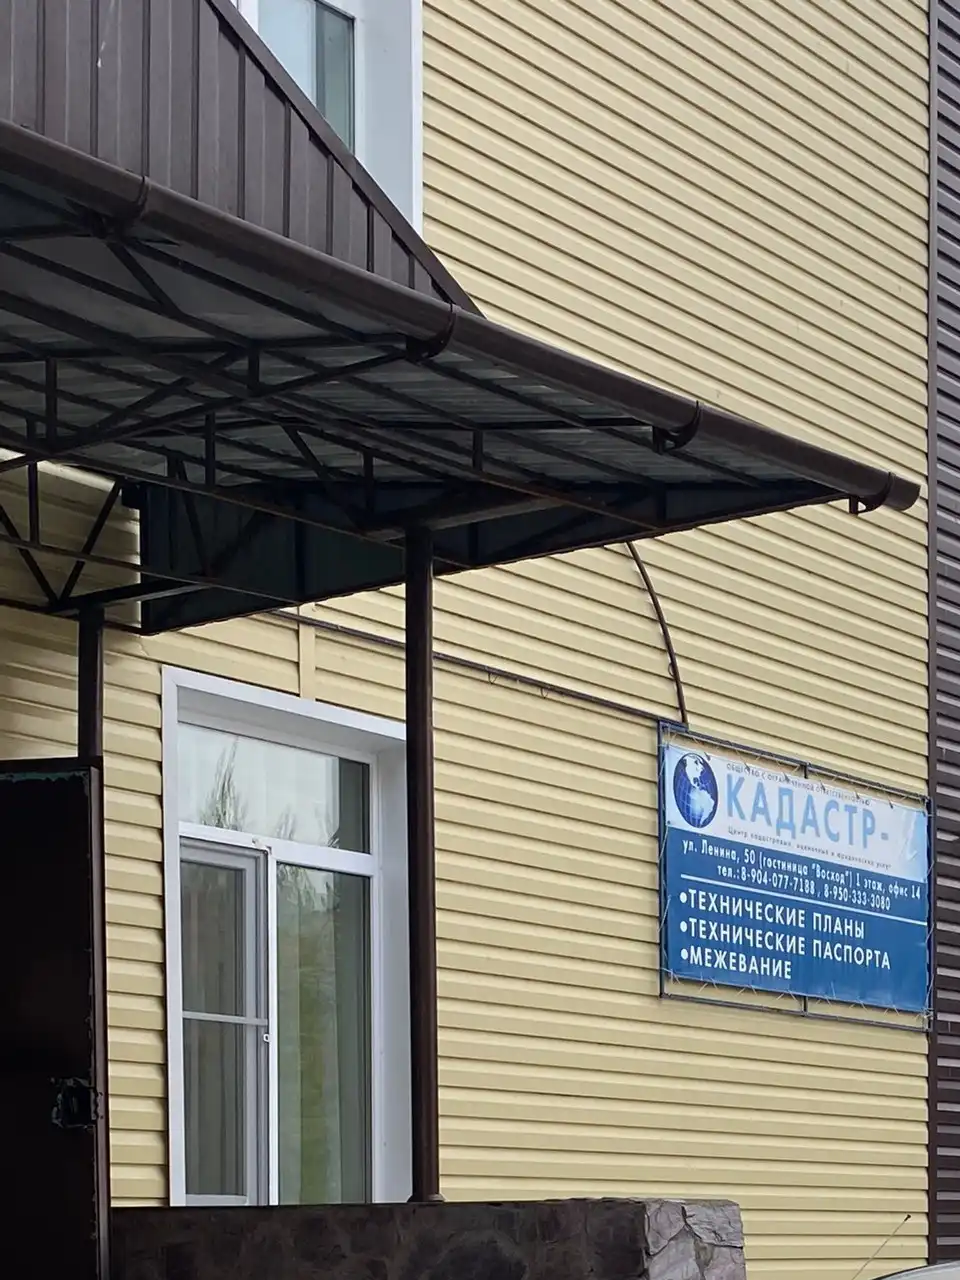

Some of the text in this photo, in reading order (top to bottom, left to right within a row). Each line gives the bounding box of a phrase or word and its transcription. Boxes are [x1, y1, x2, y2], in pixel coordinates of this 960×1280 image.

[682, 839, 698, 855] ул.
[701, 839, 740, 864] Ленина,
[744, 848, 756, 864] 50
[759, 851, 808, 876] (гостиница
[888, 881, 908, 899] офис
[911, 884, 921, 900] 14
[688, 889, 865, 939] ТЕХНИЧЕСКИЕ ПЛАНЫ
[824, 883, 891, 911] 8-950-333-3080
[688, 917, 891, 970] ТЕХНИЧЕСКИЕ ПАСПОРТА
[689, 945, 792, 979] МЕЖЕВАНИЕ
